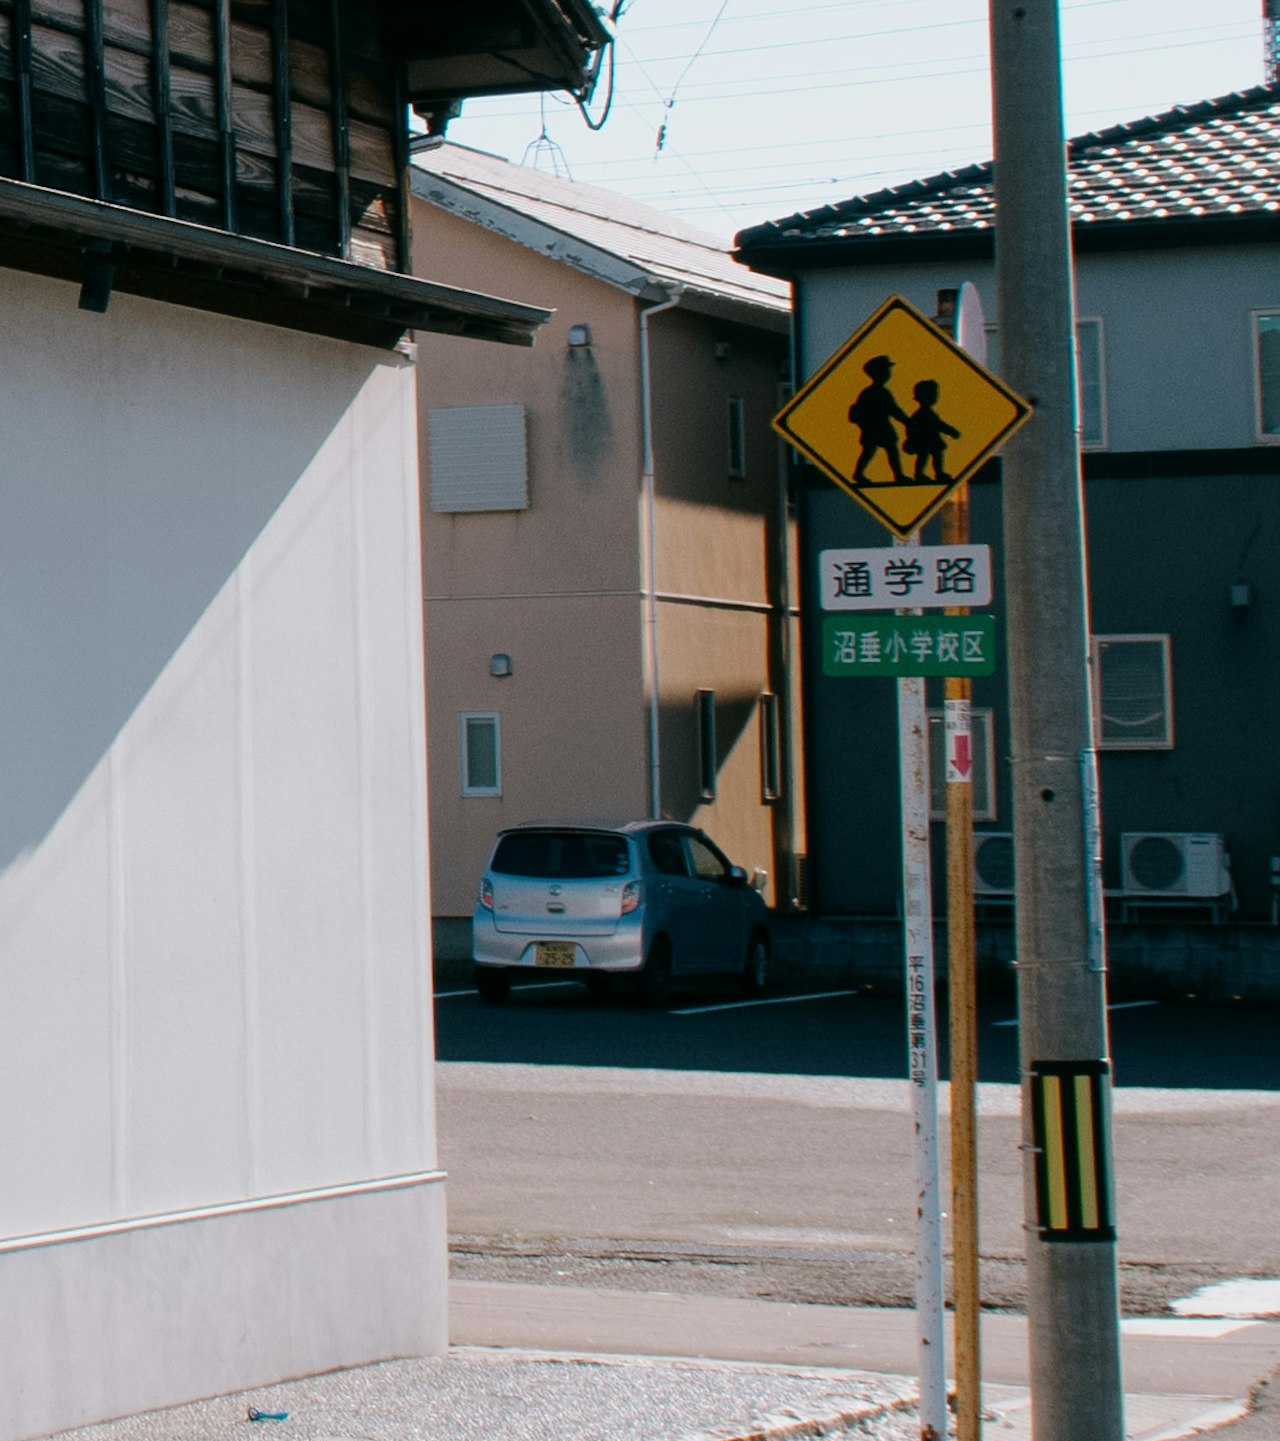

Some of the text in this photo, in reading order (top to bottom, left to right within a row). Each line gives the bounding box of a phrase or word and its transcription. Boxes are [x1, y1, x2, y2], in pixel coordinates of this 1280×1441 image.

[832, 556, 976, 598] 通学路
[833, 629, 986, 664] 沼垂小学校区
